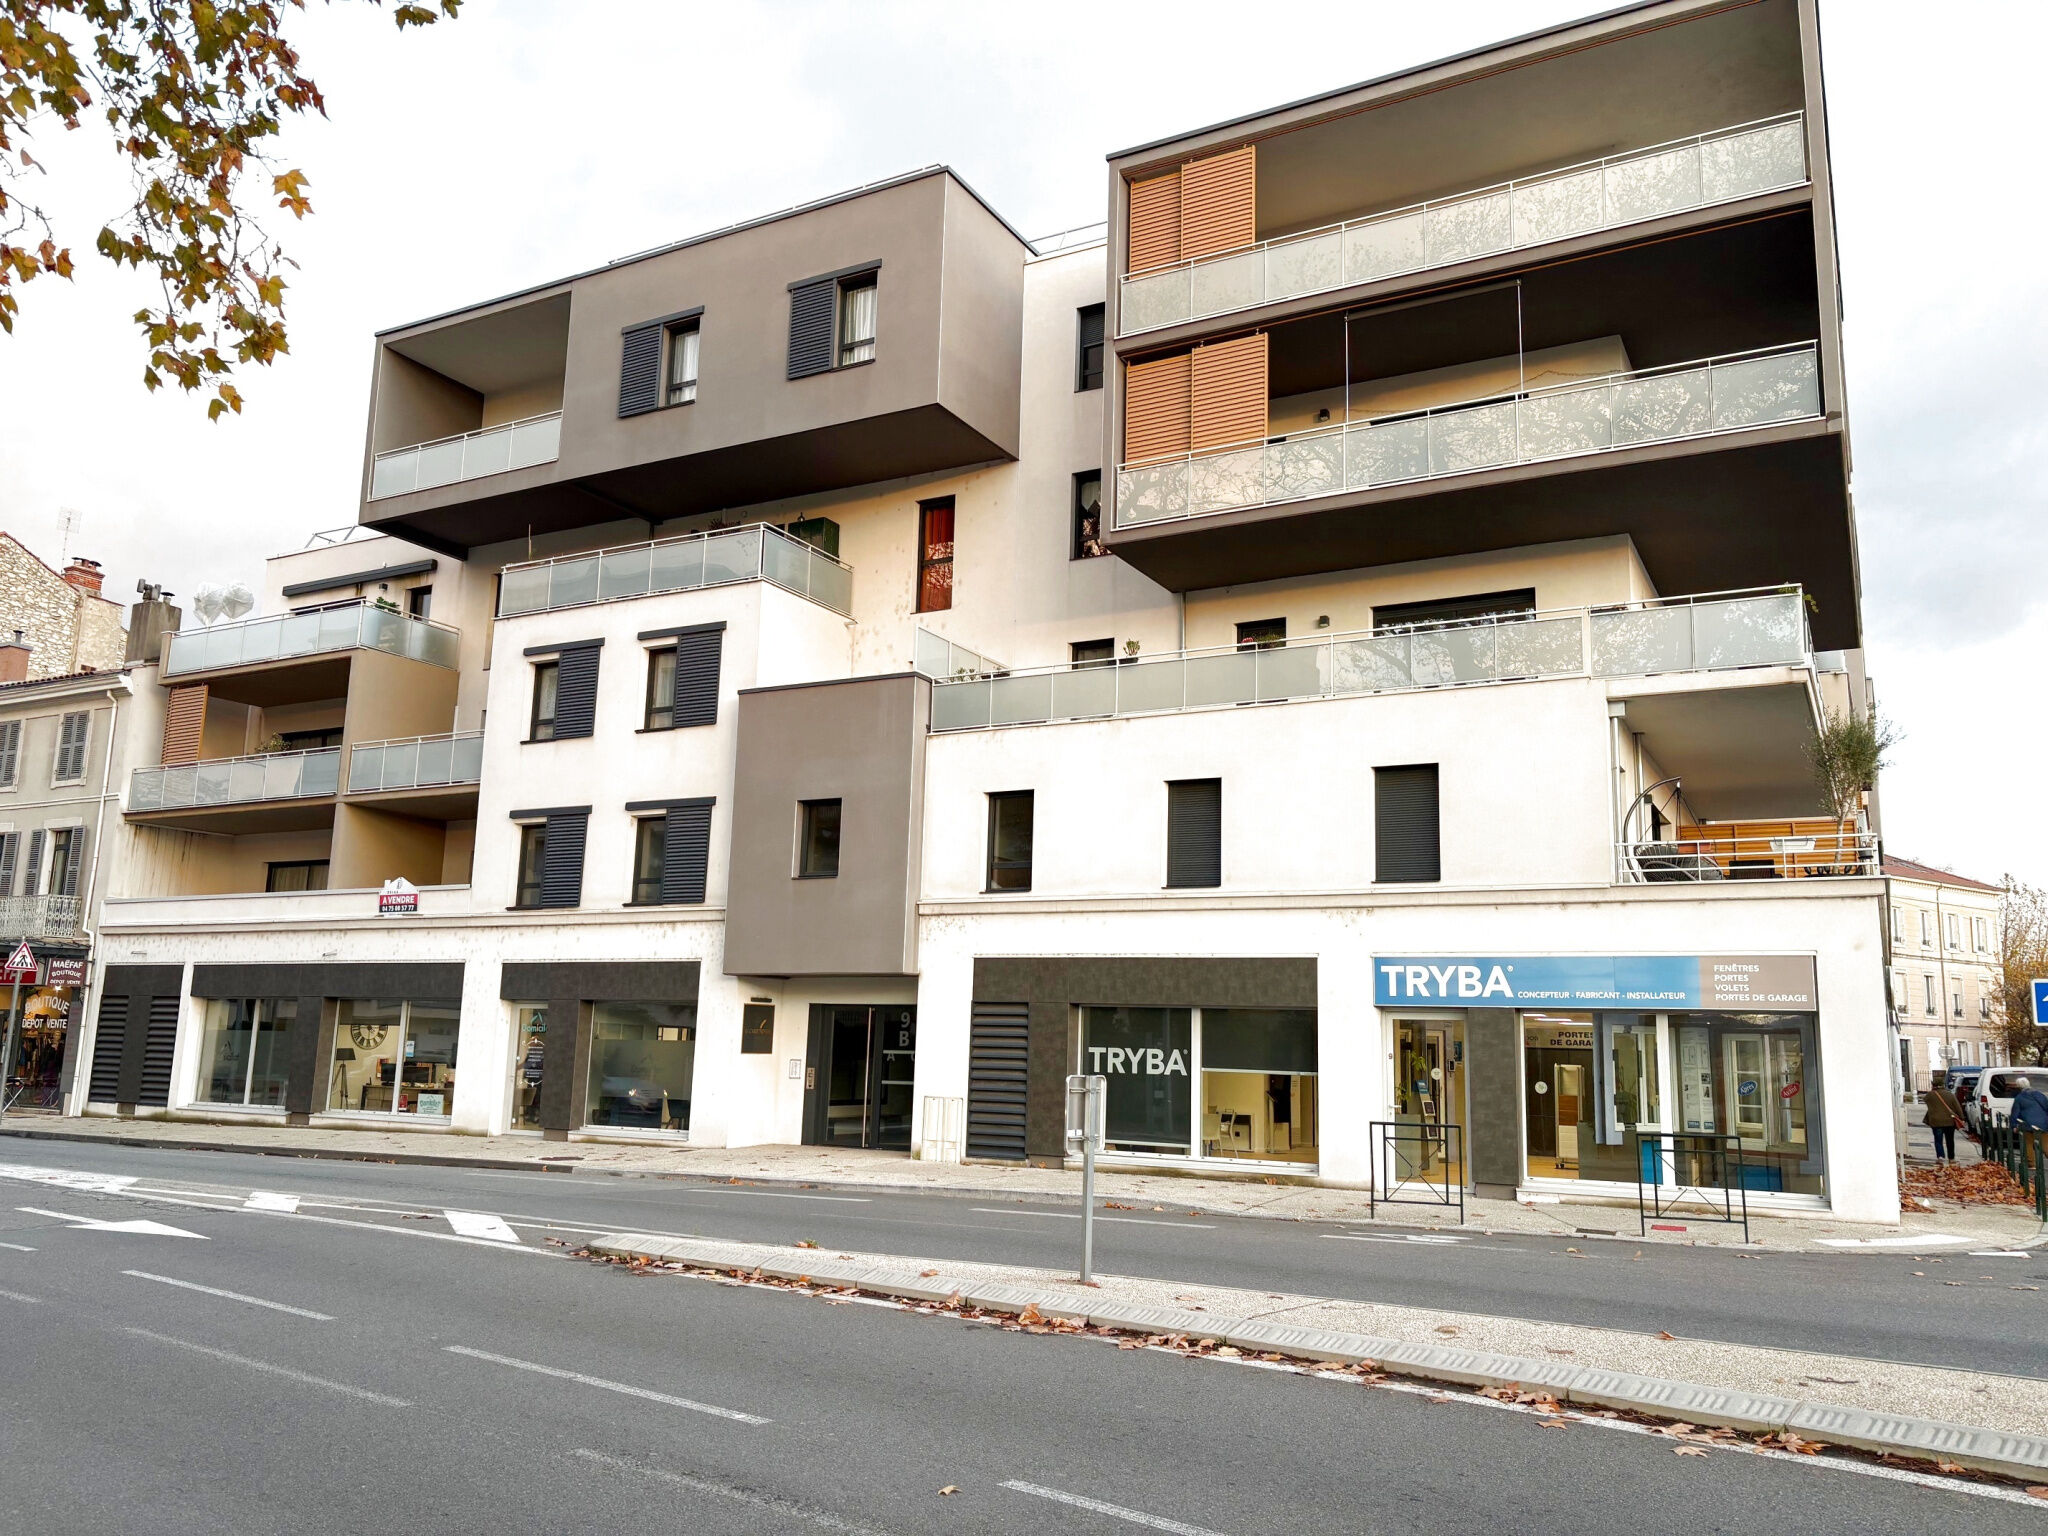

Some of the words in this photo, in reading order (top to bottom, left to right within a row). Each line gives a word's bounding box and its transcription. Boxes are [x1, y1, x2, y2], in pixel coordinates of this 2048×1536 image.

[388, 895, 415, 904] VENDRE
[1713, 963, 1760, 973] FENÊTRES
[51, 970, 82, 978] BOUTIQUE
[1714, 974, 1749, 982] PORTES
[1380, 965, 1514, 998] TRYBA
[1714, 984, 1750, 992] VOLETS
[1517, 991, 1570, 999] CONCEPTEUR
[1575, 991, 1620, 999] FABRICANT
[1626, 991, 1686, 1000] INSTALLATEUR
[1715, 993, 1750, 1001] PORTES
[1767, 994, 1808, 1002] GARAGE
[25, 995, 70, 1015] BOUTIQUE
[22, 1018, 43, 1029] DEPOT
[46, 1018, 68, 1029] VENTE
[900, 1012, 910, 1028] 9
[899, 1031, 910, 1047] B
[1565, 1039, 1594, 1047] GARA
[1088, 1046, 1188, 1076] TRYBA
